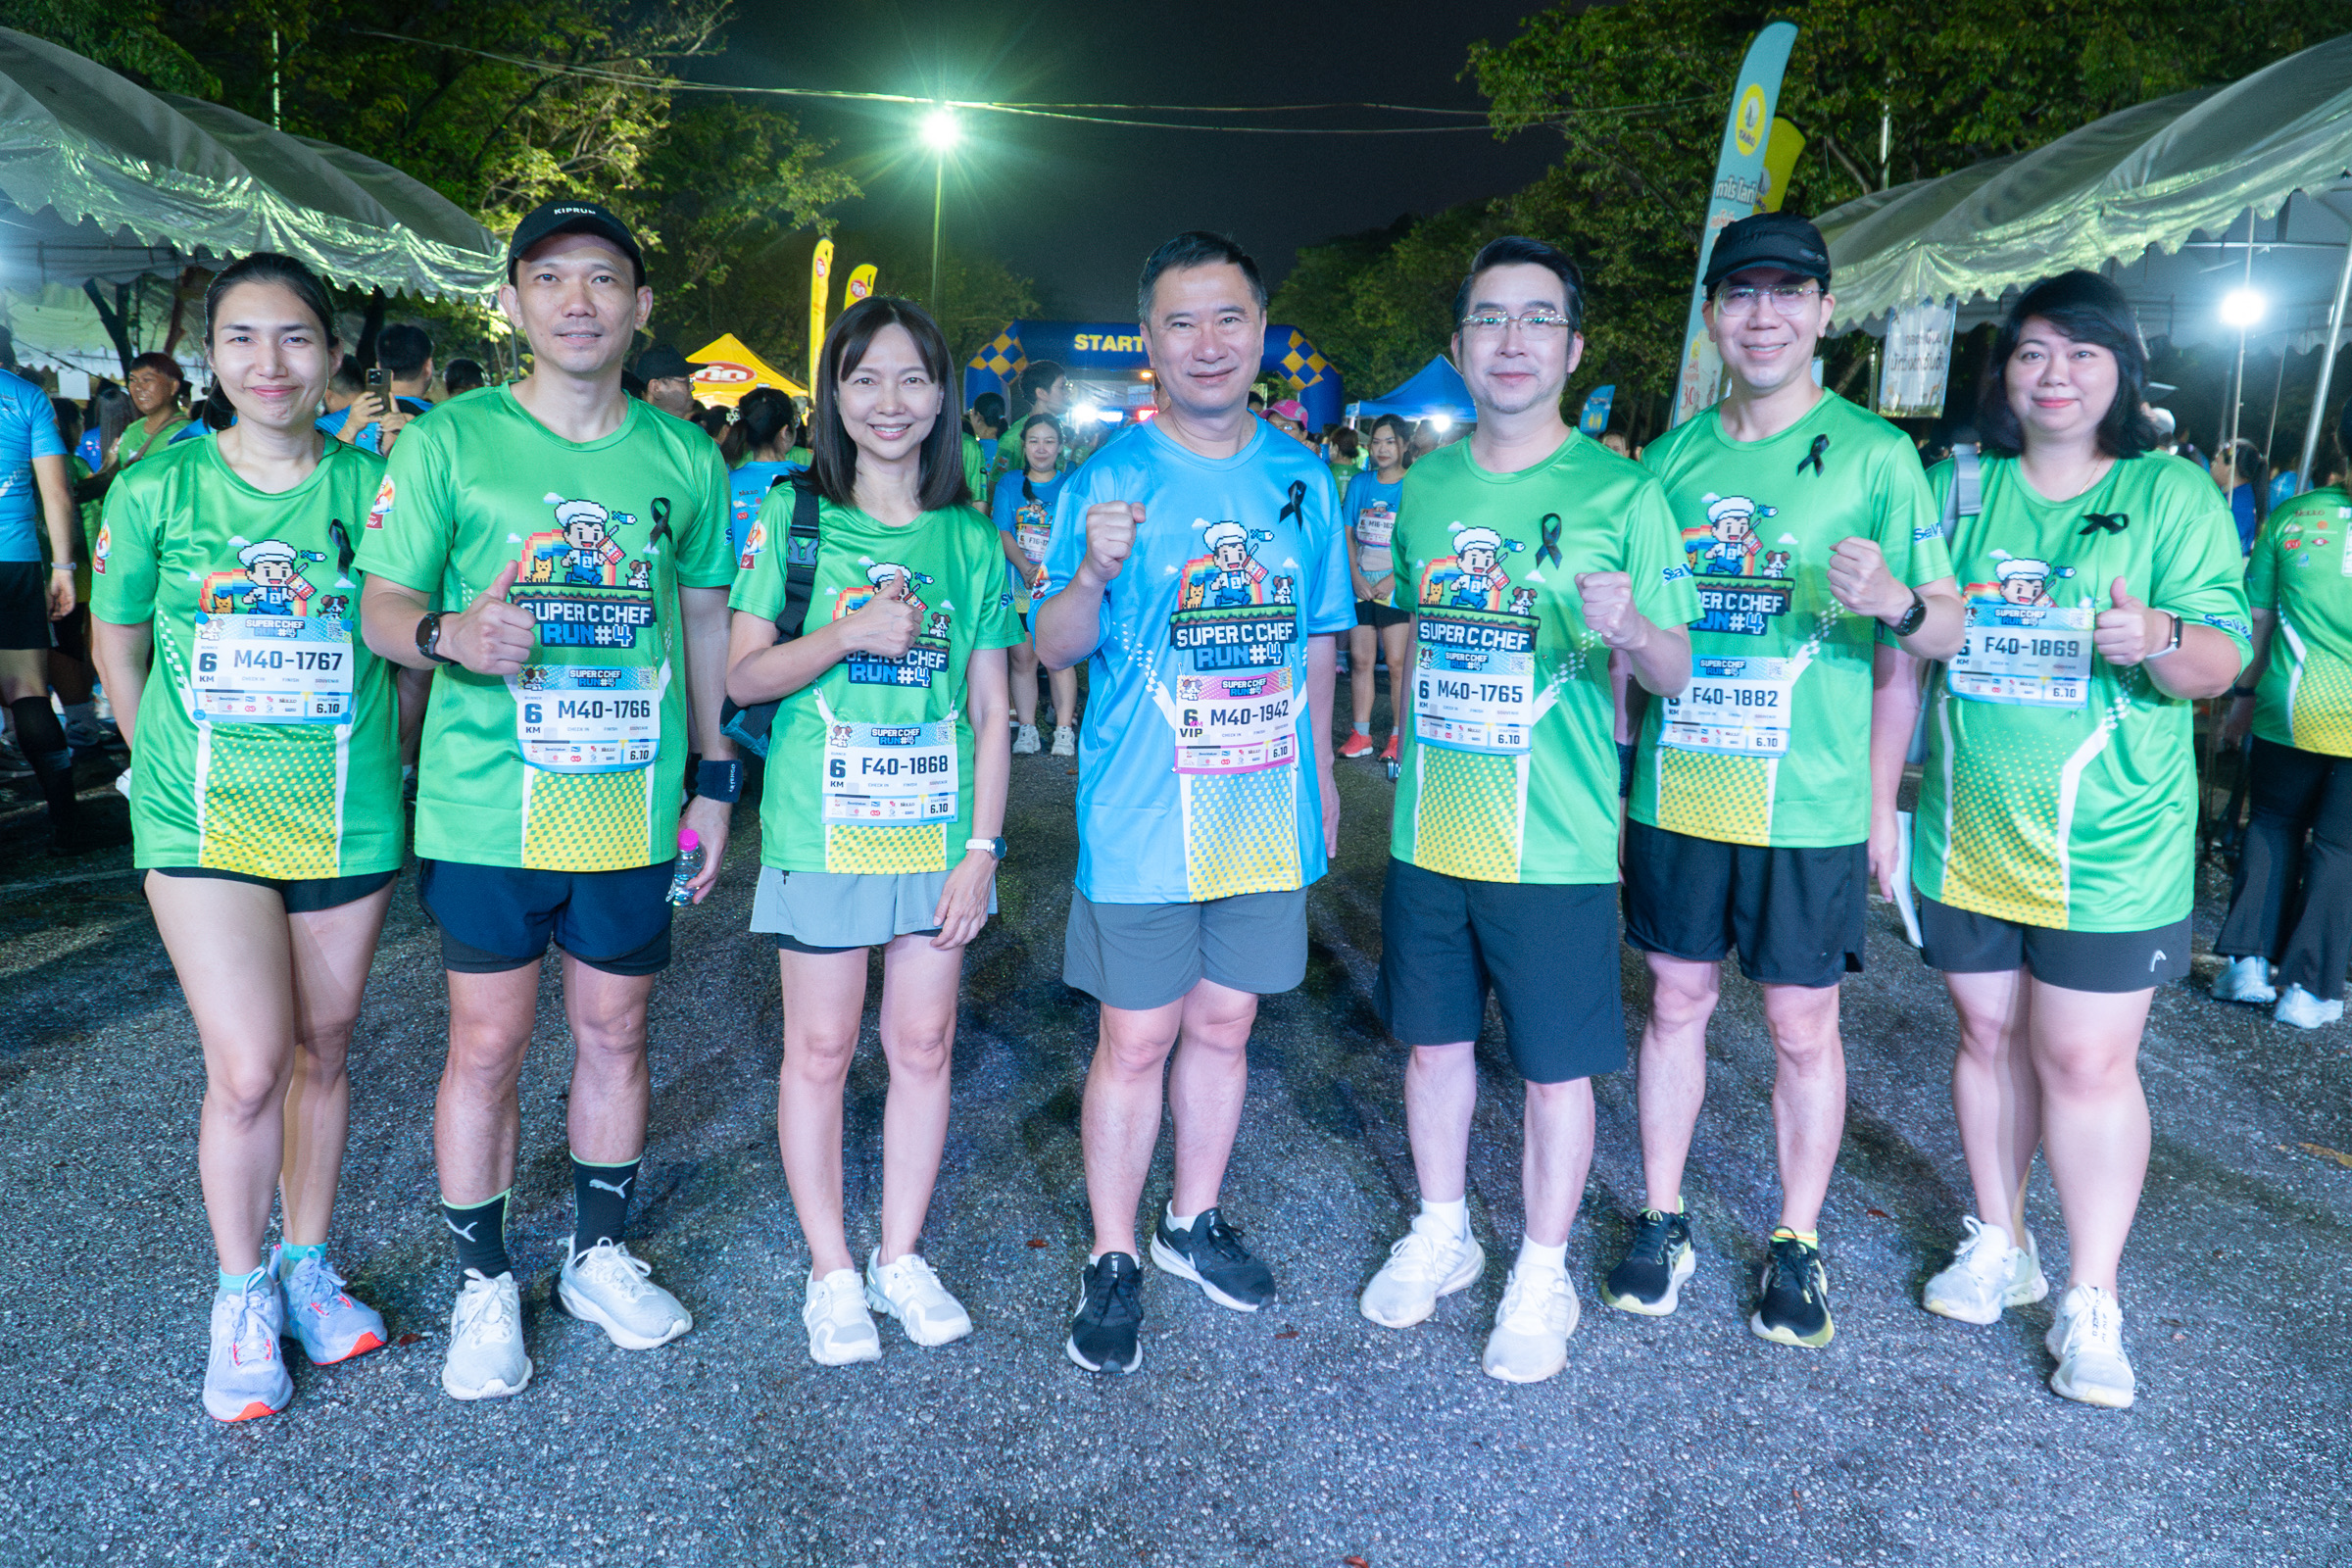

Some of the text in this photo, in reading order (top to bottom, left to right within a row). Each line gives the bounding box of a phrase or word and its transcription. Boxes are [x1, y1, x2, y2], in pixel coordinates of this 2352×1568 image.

[1074, 333, 1144, 352] START
[1726, 593, 1738, 610] C
[1739, 594, 1784, 612] CHEF
[588, 605, 600, 622] C
[603, 606, 651, 624] CHEF
[1995, 609, 2021, 617] SUPER
[282, 620, 305, 629] CHEF
[544, 623, 633, 647] RUN#4
[1177, 622, 1294, 648] SUPER C CHEF
[1420, 622, 1465, 642] SUPER
[1467, 627, 1480, 645] C
[1481, 628, 1530, 651] CHEF
[1197, 641, 1283, 668] RUN#4
[1984, 636, 2081, 658] F40-1869
[199, 653, 218, 672] 6
[233, 650, 343, 671] M40-1767
[906, 650, 947, 669] CHEF
[1446, 652, 1466, 661] SUPER
[1471, 654, 1489, 662] CHEF
[569, 669, 597, 678] SUPER
[851, 663, 931, 687] RUN#4
[1222, 680, 1248, 689] SUPER
[1253, 677, 1267, 687] CHEF
[1419, 680, 1430, 700] 6
[1438, 679, 1523, 703] M40-1765
[1692, 686, 1779, 707] F40-1882
[2053, 688, 2077, 698] 6.10
[317, 703, 340, 713] 6.10
[524, 704, 542, 723] 6
[559, 700, 651, 718] M40-1766
[1184, 709, 1199, 726] 6
[1210, 700, 1289, 726] M40-1942
[871, 728, 897, 737] SUPER
[904, 728, 920, 737] CHEF
[1179, 728, 1203, 738] VIP
[1497, 734, 1520, 745] 6.10
[1756, 737, 1779, 747] 6.10
[630, 750, 649, 760] 6.10
[1273, 746, 1288, 759] 6.10
[830, 759, 846, 778] 6
[861, 755, 948, 775] F40-1868
[930, 803, 949, 814] 6.10
